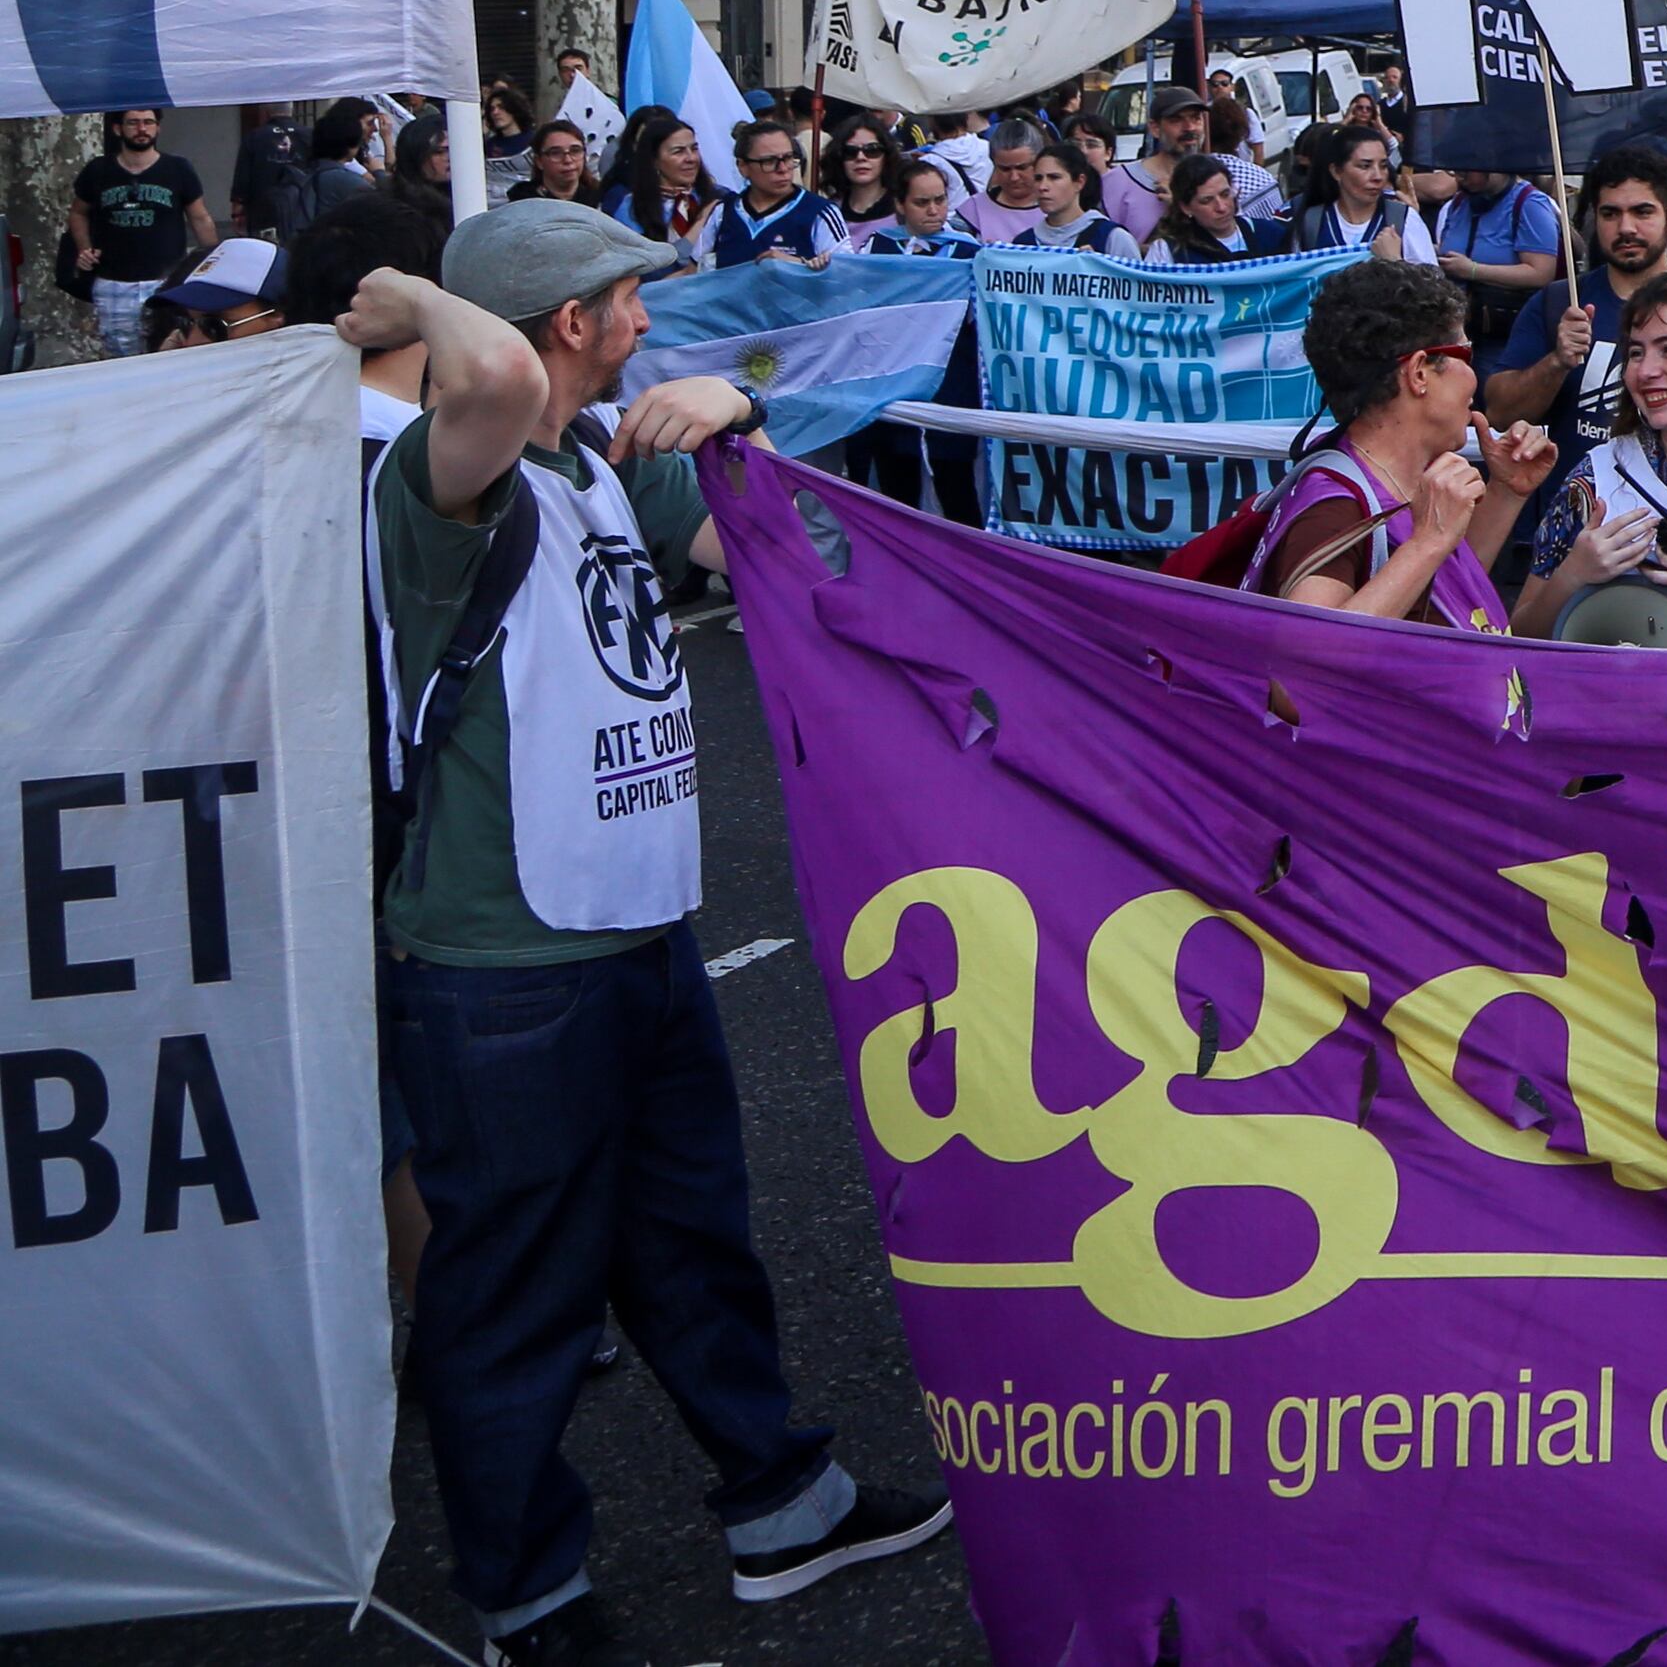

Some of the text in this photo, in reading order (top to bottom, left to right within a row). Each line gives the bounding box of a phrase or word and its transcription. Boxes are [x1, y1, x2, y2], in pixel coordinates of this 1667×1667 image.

[985, 265, 1215, 304] JARDÍN MATERNO INFANTIL
[985, 301, 1216, 361] MI PEQUEÑA
[990, 353, 1219, 423] CIUDAD
[593, 720, 646, 774] ATE
[596, 774, 674, 821] CAPITAL
[1265, 1367, 1615, 1500] gremial
